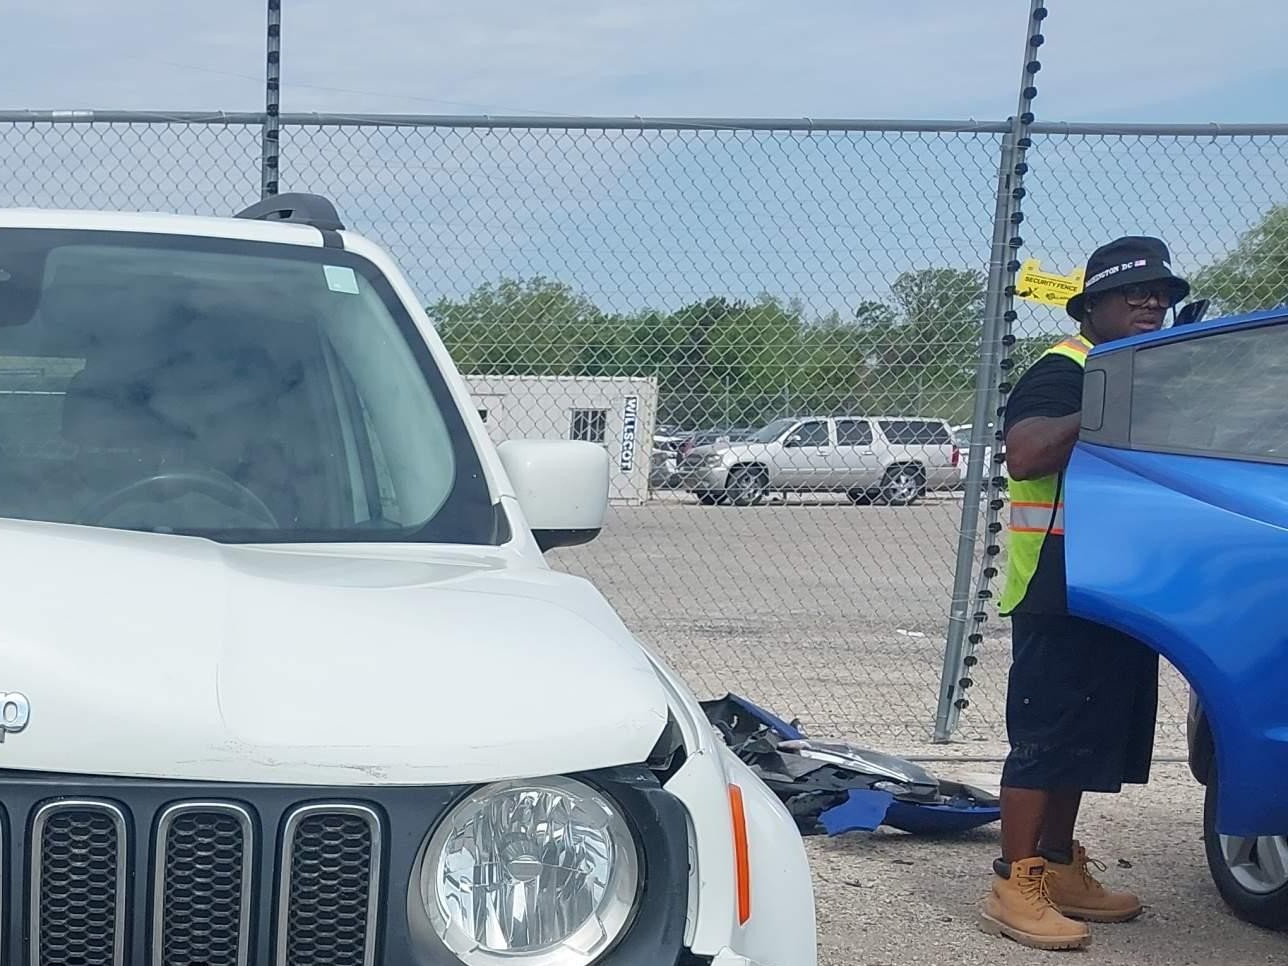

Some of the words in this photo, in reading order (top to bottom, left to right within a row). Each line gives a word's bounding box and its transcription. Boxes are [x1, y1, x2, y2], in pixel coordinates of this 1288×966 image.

[1121, 262, 1133, 271] DC
[1024, 276, 1057, 287] SECURITY
[1056, 282, 1078, 292] FENCE
[621, 398, 637, 469] WILLSCOT
